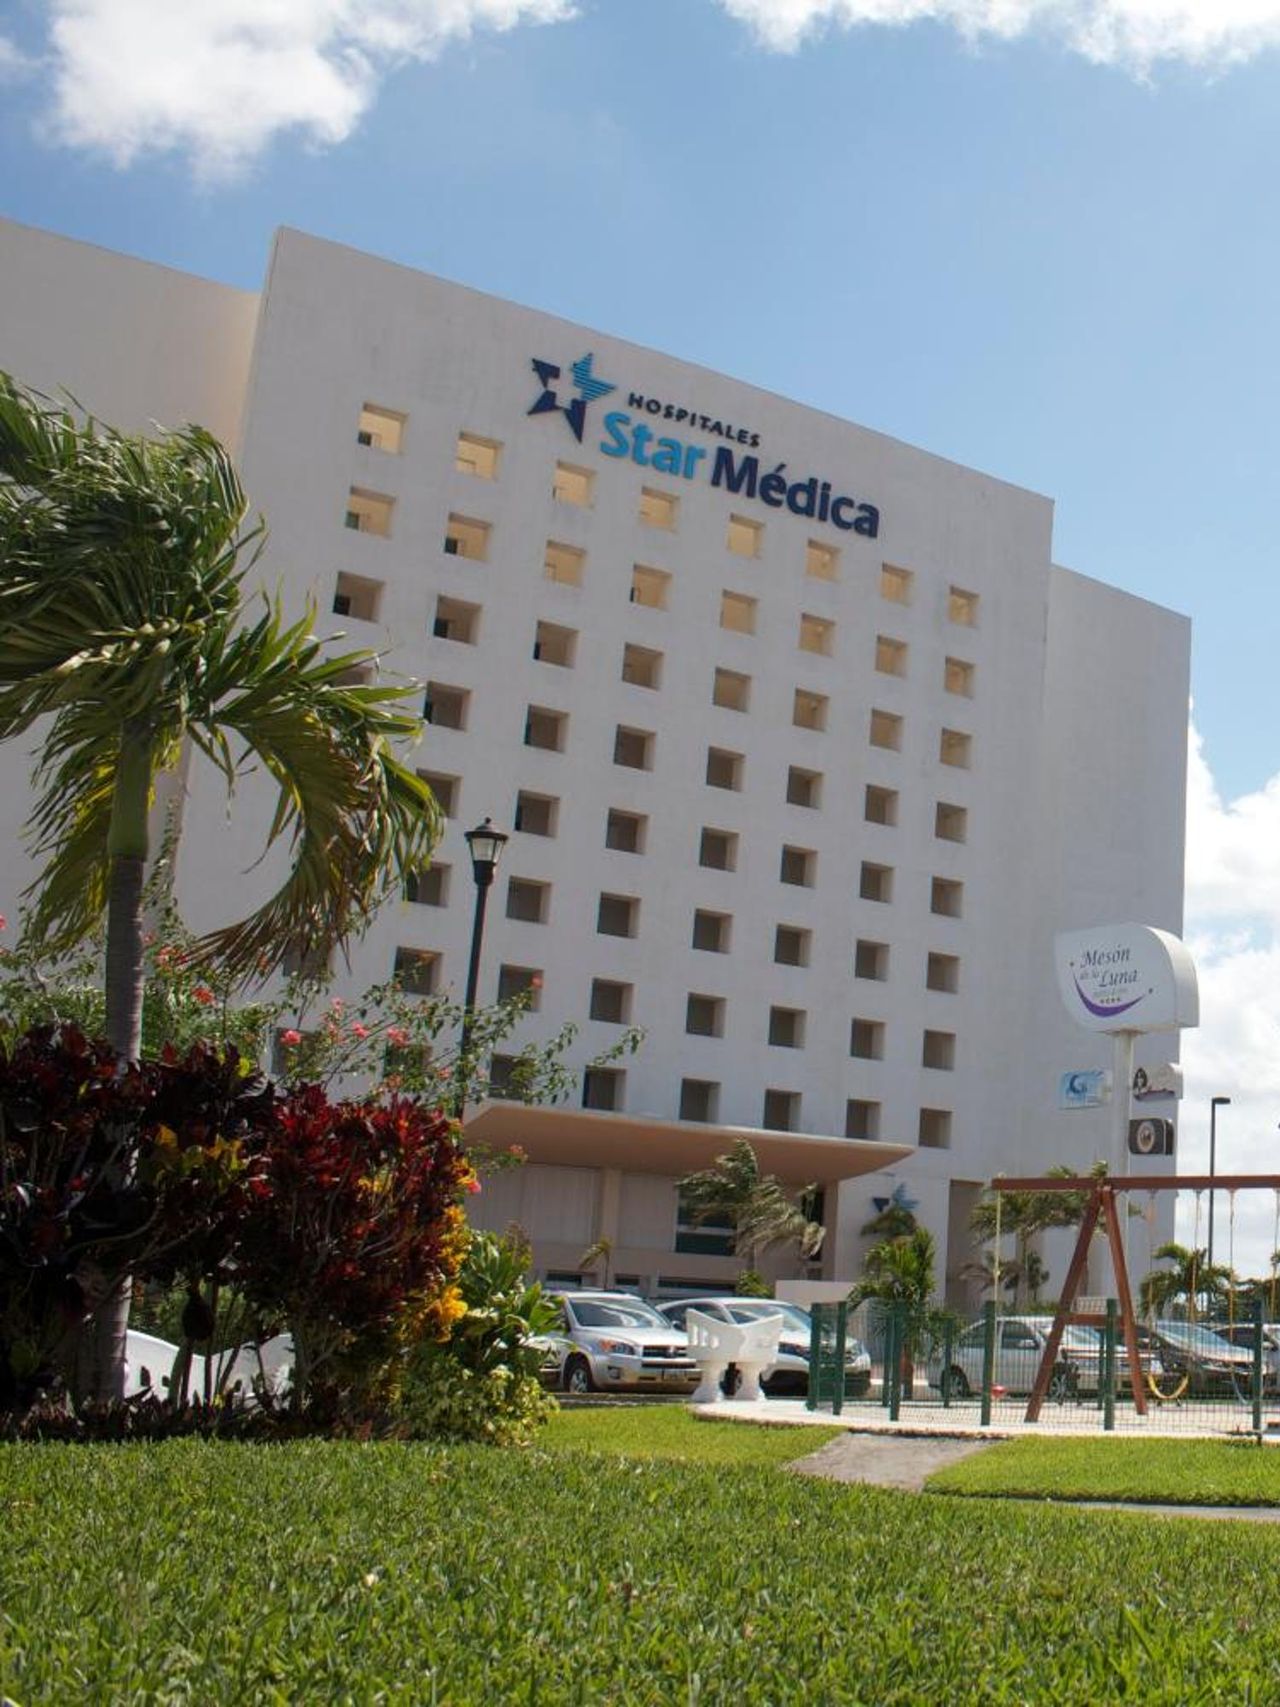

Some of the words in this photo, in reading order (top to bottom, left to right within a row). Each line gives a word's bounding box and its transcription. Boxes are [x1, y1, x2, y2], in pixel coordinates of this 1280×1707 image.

[627, 392, 761, 449] HOSPITALES
[599, 411, 706, 480] Star
[709, 445, 881, 539] Médica
[1099, 968, 1140, 988] Luna
